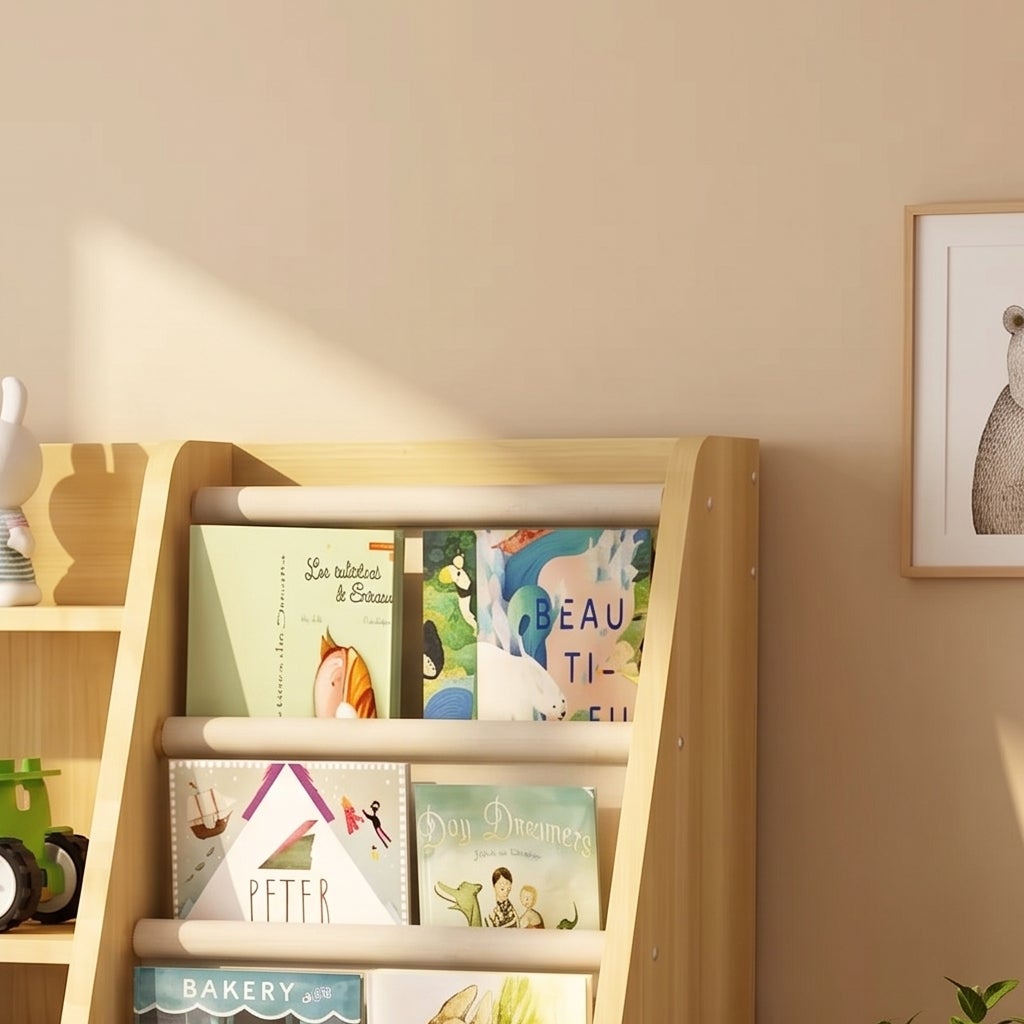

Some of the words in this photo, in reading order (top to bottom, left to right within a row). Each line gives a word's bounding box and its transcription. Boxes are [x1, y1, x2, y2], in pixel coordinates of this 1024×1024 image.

[535, 598, 624, 630] BEAU
[564, 652, 616, 684] TI-
[183, 978, 295, 1002] BAKERY
